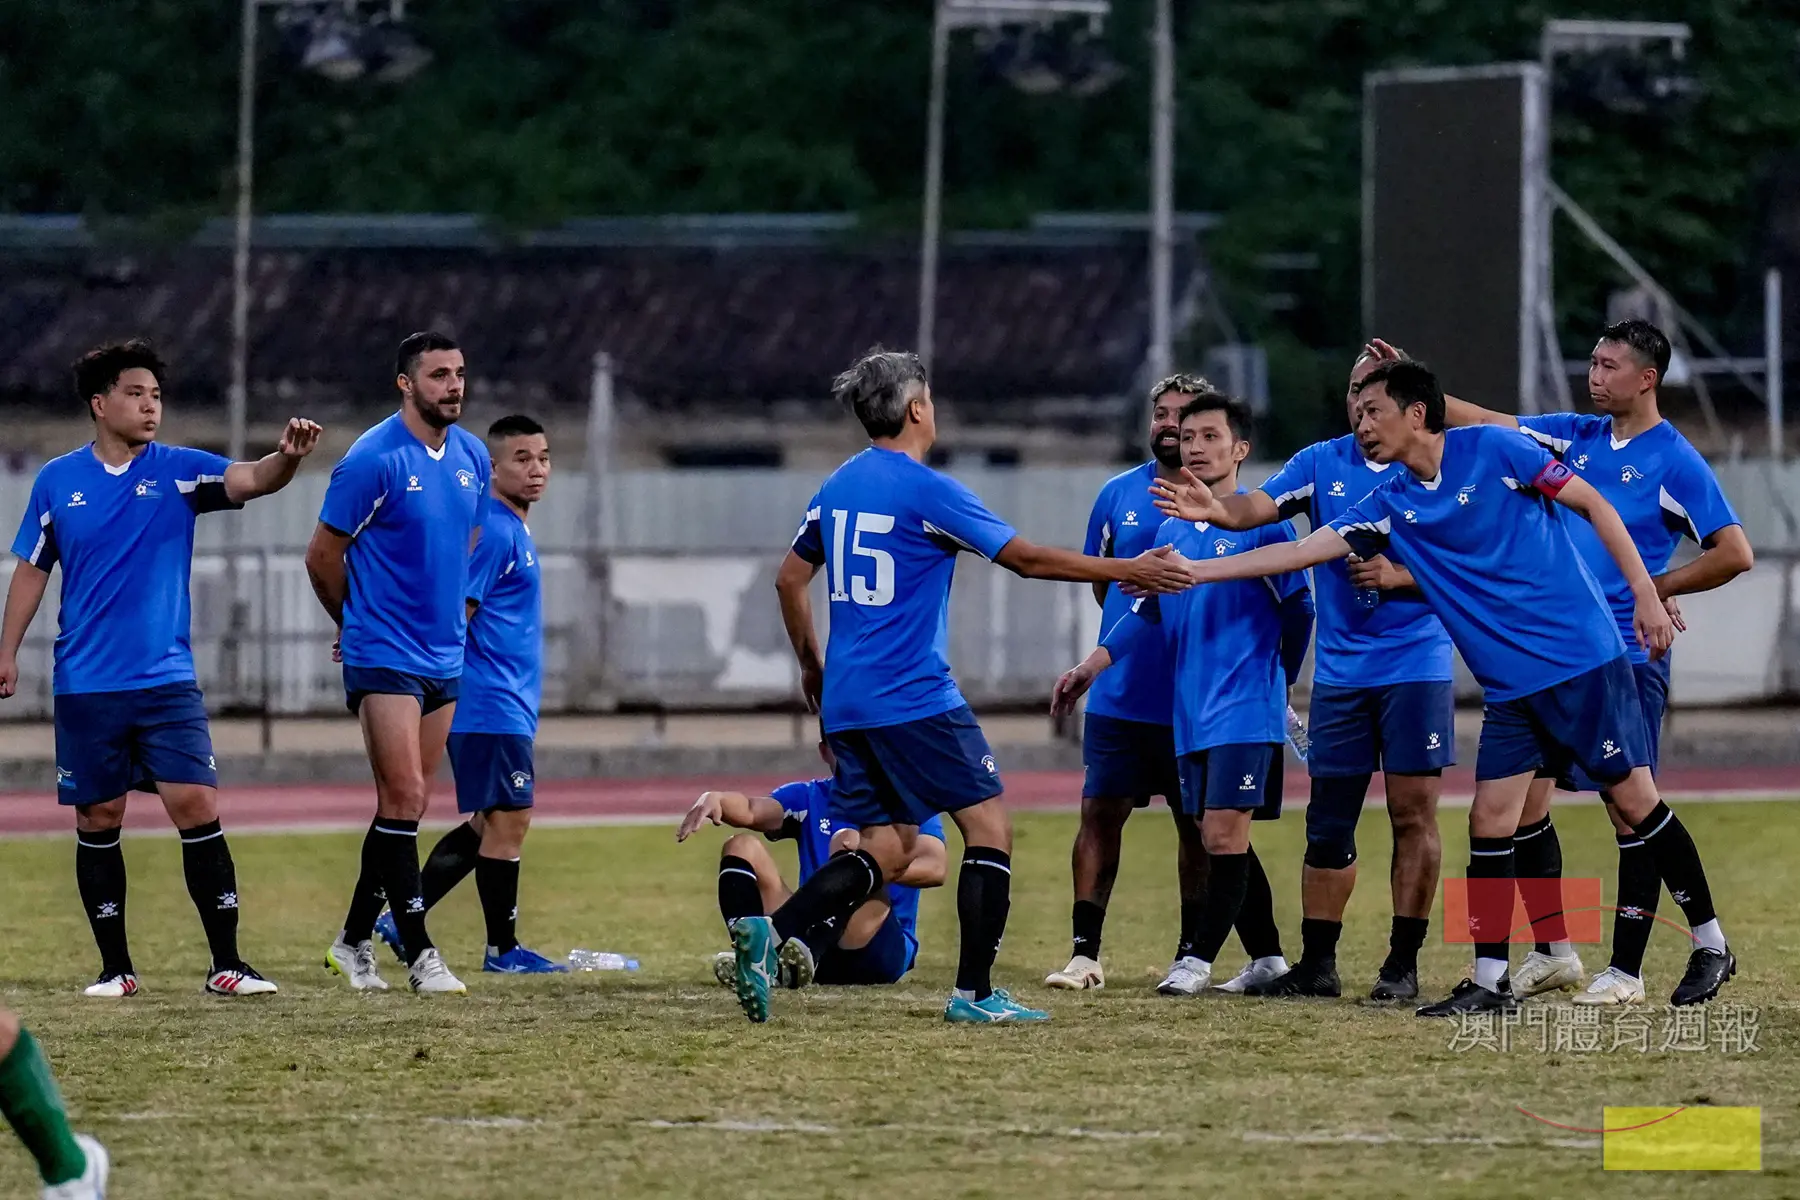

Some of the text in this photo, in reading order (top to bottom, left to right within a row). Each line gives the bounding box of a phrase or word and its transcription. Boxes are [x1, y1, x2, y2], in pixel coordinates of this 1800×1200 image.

[831, 509, 896, 607] 15
[1426, 742, 1441, 750] KELME
[1603, 747, 1622, 759] KELME
[1619, 912, 1644, 920] KELME
